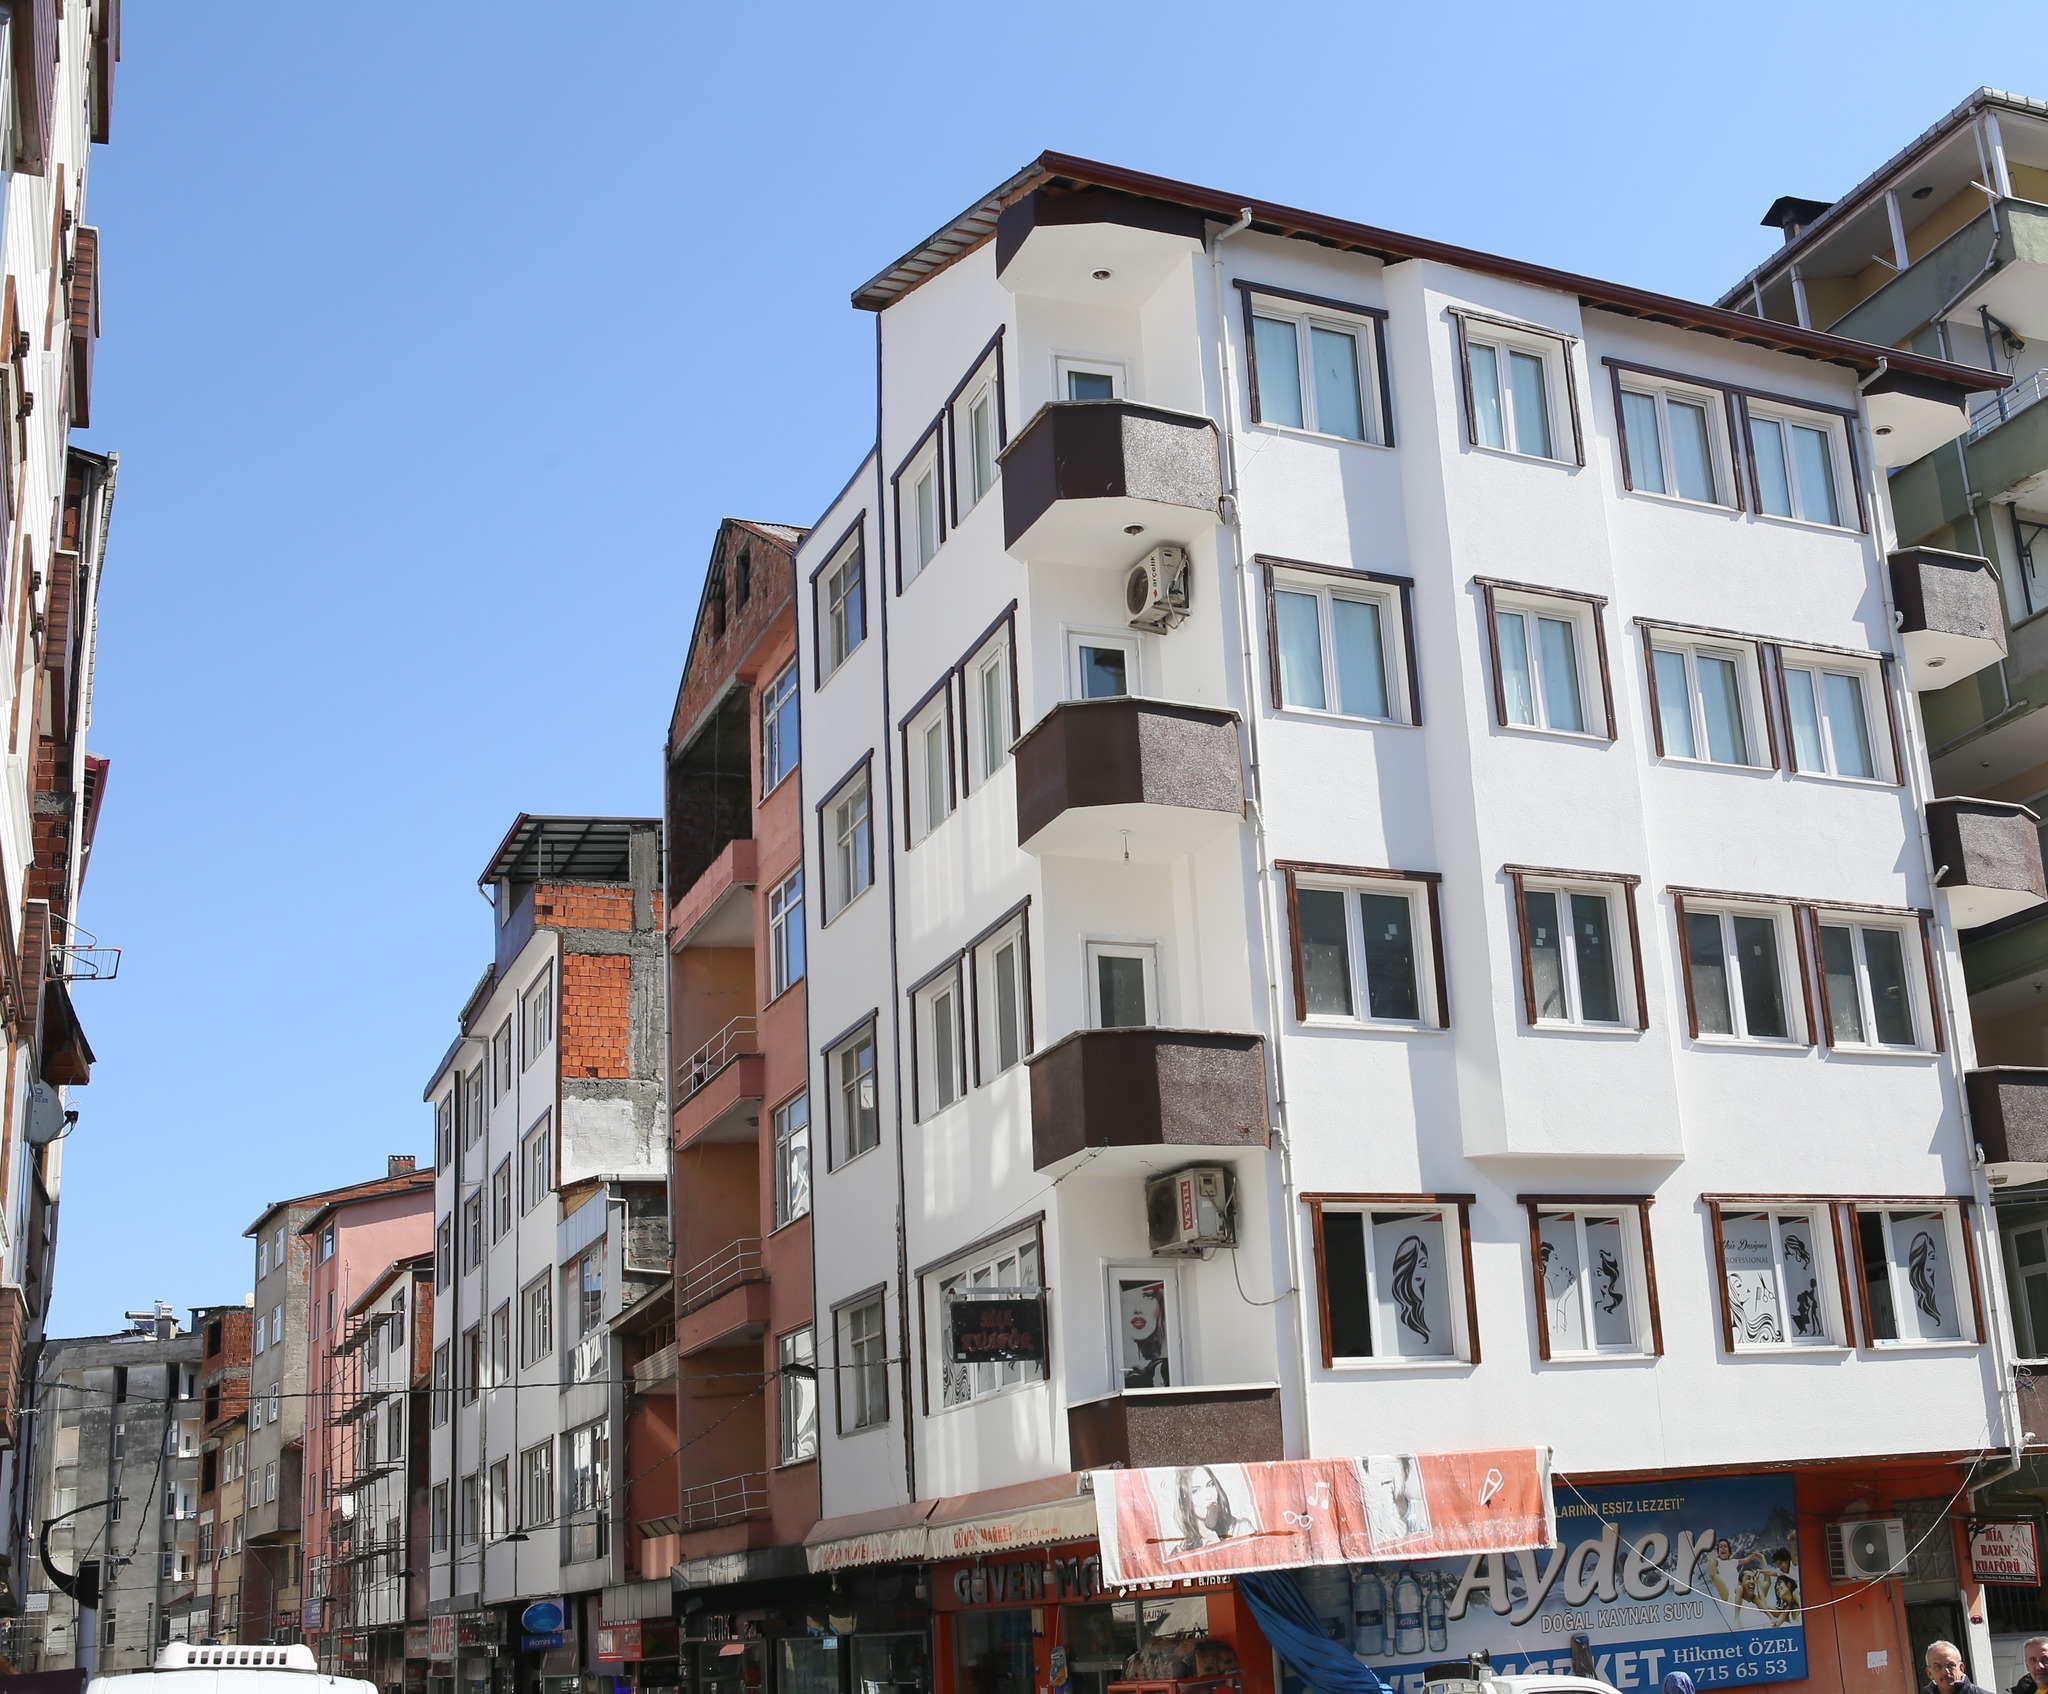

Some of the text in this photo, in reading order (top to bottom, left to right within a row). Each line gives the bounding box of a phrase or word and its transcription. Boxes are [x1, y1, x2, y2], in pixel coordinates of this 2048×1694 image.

[1182, 1182, 1192, 1229] VESTEL
[1554, 1502, 1599, 1518] LARININ
[1602, 1498, 1634, 1517] EŞSİZ
[1980, 1544, 2012, 1557] BAYAN
[1447, 1521, 1717, 1627] Ayder
[1975, 1557, 2021, 1574] KUAFÖRÜ
[1540, 1600, 1705, 1634] DOĞAL KAYNAK SUYU
[1673, 1637, 1799, 1664] Hikmet ÖZEL
[1694, 1659, 1788, 1683] 715 65 53
